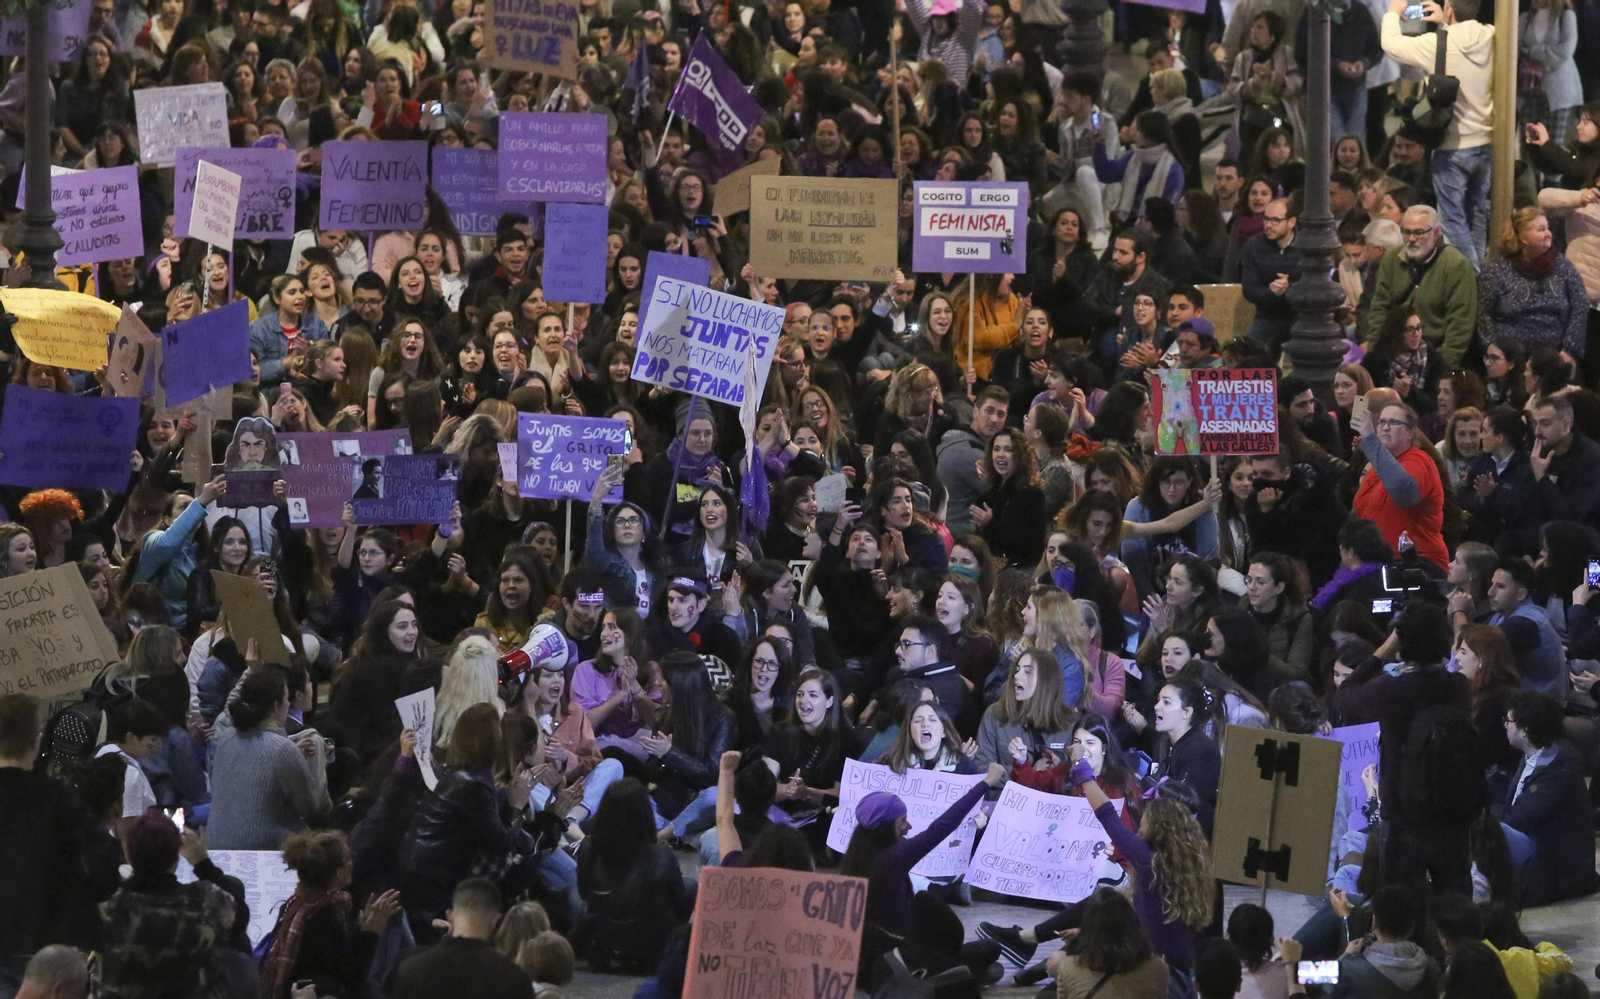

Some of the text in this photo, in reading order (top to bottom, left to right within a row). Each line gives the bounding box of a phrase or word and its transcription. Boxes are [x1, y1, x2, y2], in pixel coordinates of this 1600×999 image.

[512, 33, 562, 65] LUZ
[529, 122, 564, 134] ANILLO
[572, 123, 598, 133] PARA
[329, 154, 423, 182] VALENTÍA
[511, 160, 518, 169] Y
[523, 161, 539, 171] EN
[545, 162, 557, 172] LA
[922, 192, 1011, 203] COGITO ERGO
[234, 212, 285, 233] iBRE
[328, 200, 423, 224] FEMENINO
[775, 208, 803, 223] UNA
[929, 213, 1007, 232] FEMINISTA
[70, 218, 84, 232] NO
[65, 233, 120, 255] CALLADITAS
[955, 247, 979, 255] SUM
[656, 280, 784, 334] SI NO LUCHAMOS
[680, 316, 769, 358] JUNTAS
[644, 331, 744, 375] NOS MATARAN
[633, 351, 745, 403] POR SEPARAD
[1198, 370, 1273, 380] POR LAS
[1198, 380, 1274, 394] TRAVESTIS
[1199, 393, 1274, 406] Y MUJERES
[1199, 405, 1275, 420] TRANS
[526, 420, 625, 443] JUNTAS SOMOS
[1200, 420, 1276, 433] ASESINADAS
[532, 435, 613, 455] el GRITO
[1200, 442, 1275, 452] A LAS CALLES?
[1240, 433, 1274, 442] SALISTE
[551, 454, 573, 473] las
[582, 458, 602, 473] que
[524, 474, 540, 490] NO
[549, 475, 581, 493] TIENEN
[0, 578, 54, 610] SICIÓN
[5, 604, 80, 634] FAVORITA ES
[0, 648, 21, 666] BA
[30, 637, 56, 656] YO
[18, 675, 37, 691] EL
[36, 658, 104, 686] PATRIARCADO
[1003, 789, 1028, 811] MI
[1035, 800, 1071, 820] VIDA
[1065, 840, 1094, 861] MI
[981, 853, 1038, 877] CUERPO
[972, 868, 991, 884] NO
[995, 876, 1035, 894] TIENE
[703, 873, 787, 912] SOMOS
[802, 880, 866, 931] GRITO
[701, 920, 737, 950] DE
[785, 929, 827, 957] QUE
[829, 936, 855, 961] YA
[699, 952, 721, 974] NO
[812, 963, 856, 999] VOZ
